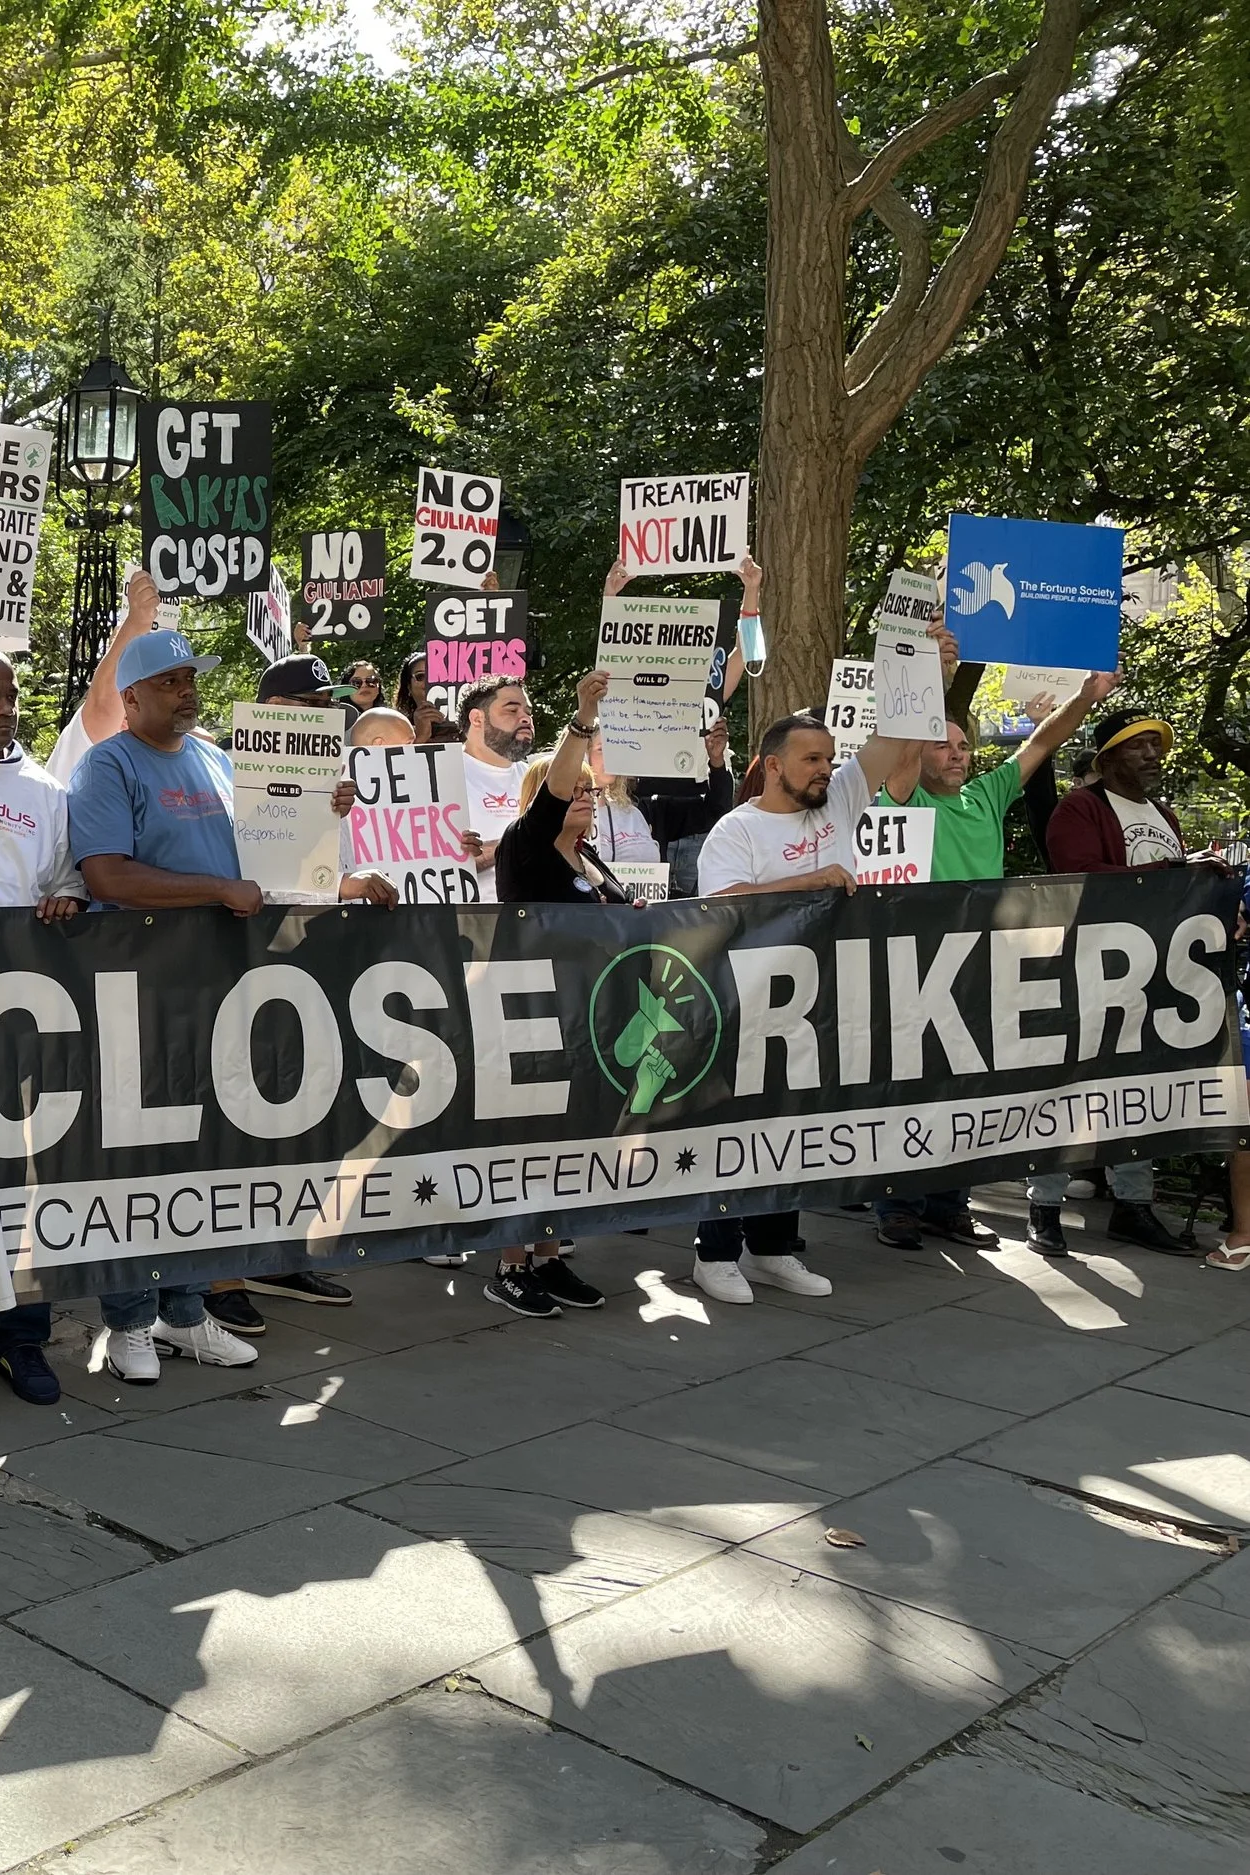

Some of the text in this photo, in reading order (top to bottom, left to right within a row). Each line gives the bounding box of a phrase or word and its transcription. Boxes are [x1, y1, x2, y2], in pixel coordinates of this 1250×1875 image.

[157, 408, 240, 478] GET
[150, 474, 268, 532] RIKERS
[422, 471, 494, 512] NO
[625, 476, 746, 510] TREATMENT
[416, 506, 498, 537] GIULIANI
[310, 531, 363, 580] NO
[421, 533, 491, 574] 2.0
[621, 515, 735, 566] NOT JAIL
[150, 534, 264, 596] CLOSED
[8, 570, 28, 598] &
[304, 578, 385, 604] GIULIANI
[901, 576, 932, 592] WHEN WE
[1020, 581, 1115, 599] The Fortune Society
[1021, 592, 1049, 600] BUILDING
[310, 600, 371, 636] 2.0
[434, 597, 512, 637] GET
[624, 603, 699, 614] WHEN WE
[884, 592, 910, 617] CLOSE
[601, 622, 715, 647] CLOSE RIKERS
[879, 623, 896, 634] NEW
[897, 627, 918, 638] YORK
[427, 638, 527, 684] RIKERS
[599, 654, 710, 666] NEW YORK CITY
[1015, 670, 1070, 686] JUSTICE
[252, 710, 324, 724] WHEN WE
[831, 704, 856, 728] 13
[234, 728, 342, 758] CLOSE RIKERS
[234, 762, 339, 777] NEW YORK CITY
[349, 745, 446, 805] GET
[269, 786, 300, 795] WILL BE
[351, 803, 470, 864] RIKERS
[856, 812, 907, 856] GET
[405, 868, 480, 904] OSED
[728, 914, 1228, 1097] RIKERS
[0, 1078, 1227, 1256] ECARCERATE DEFEND DIVEST & REDISTRIBUTE
